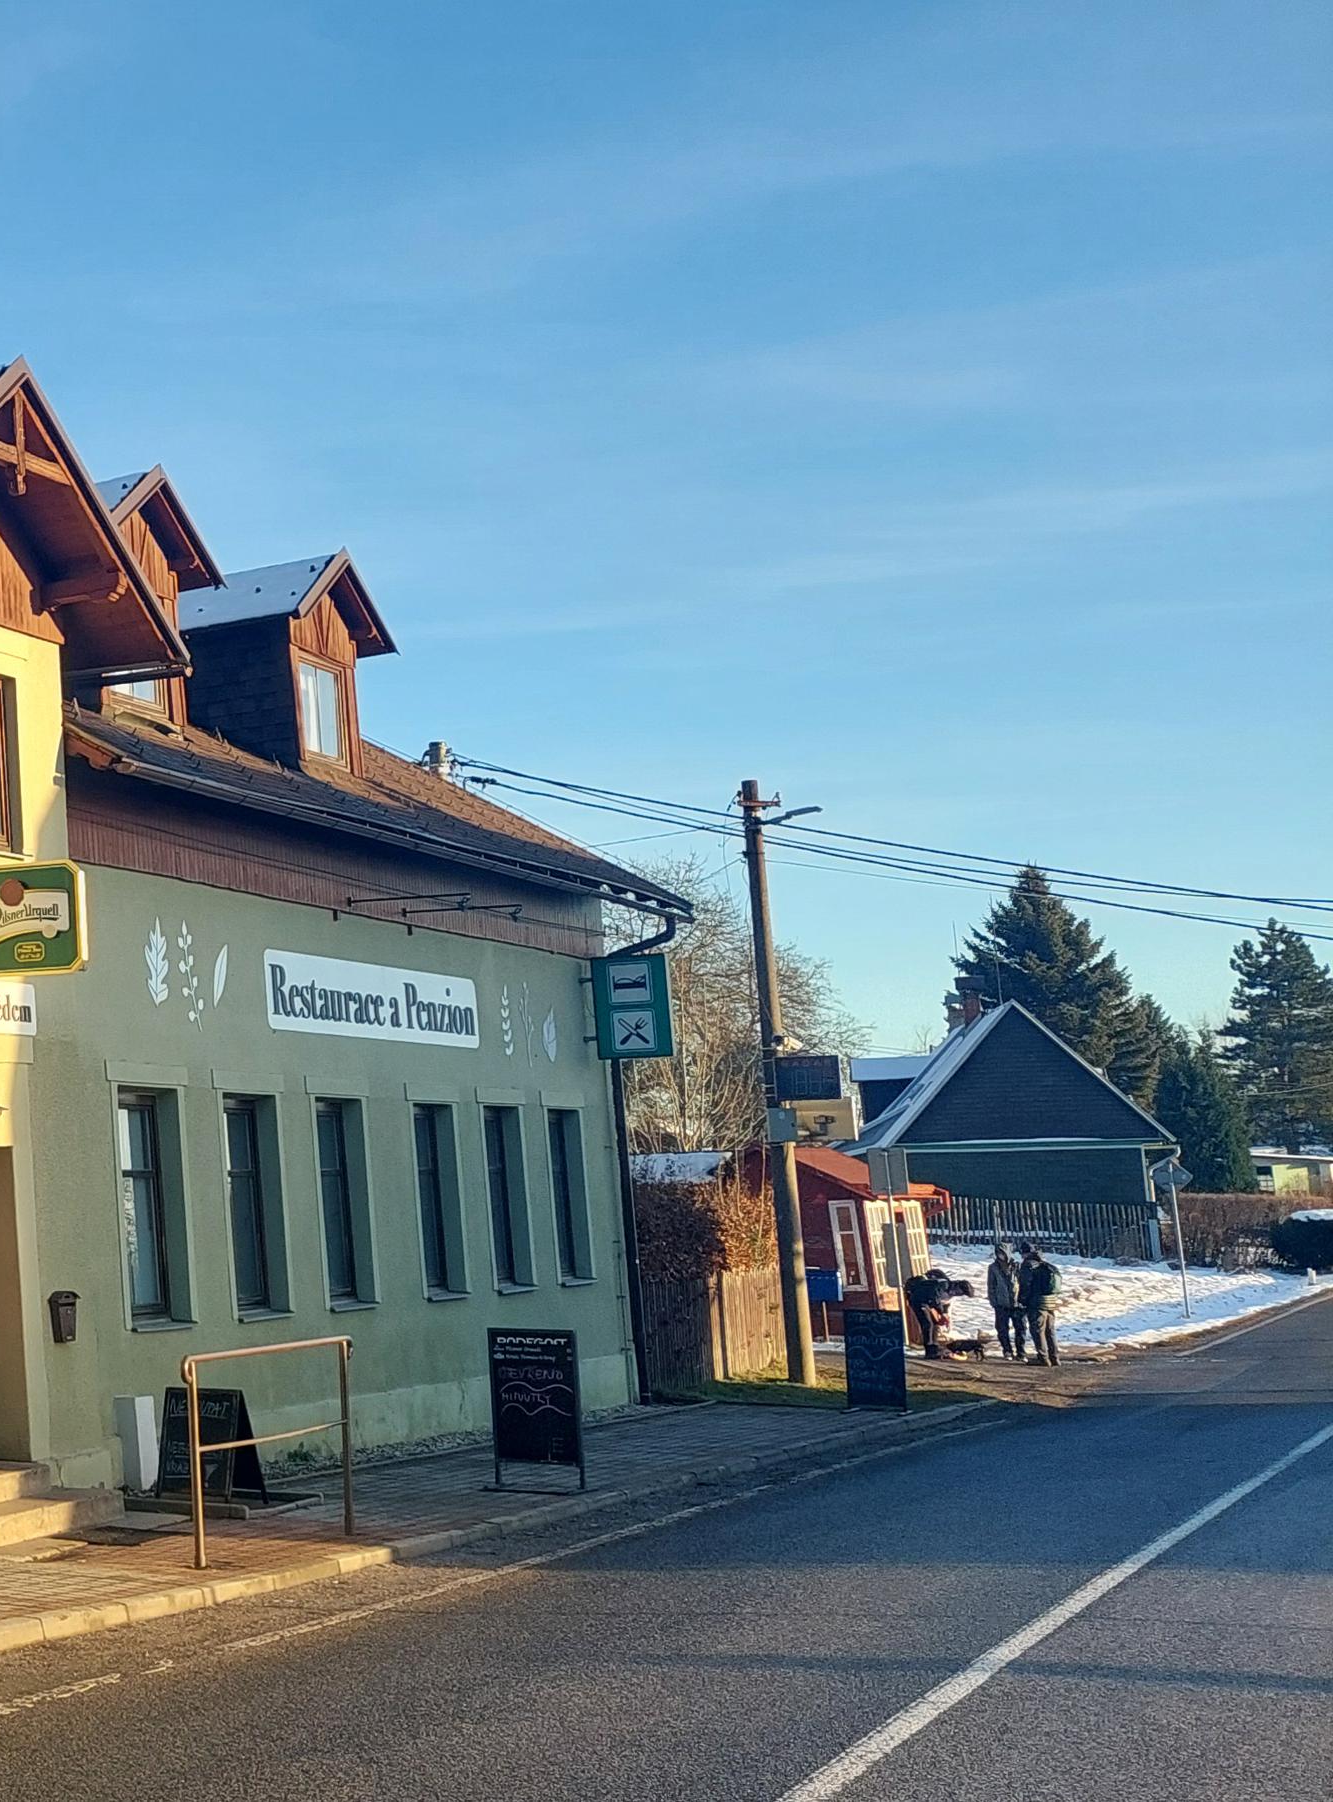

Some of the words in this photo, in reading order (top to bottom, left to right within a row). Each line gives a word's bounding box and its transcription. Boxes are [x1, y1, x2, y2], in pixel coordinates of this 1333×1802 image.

[24, 903, 59, 922] Urquell
[268, 963, 386, 1027] Restaurace
[390, 996, 402, 1028] a
[403, 982, 476, 1036] Penzion
